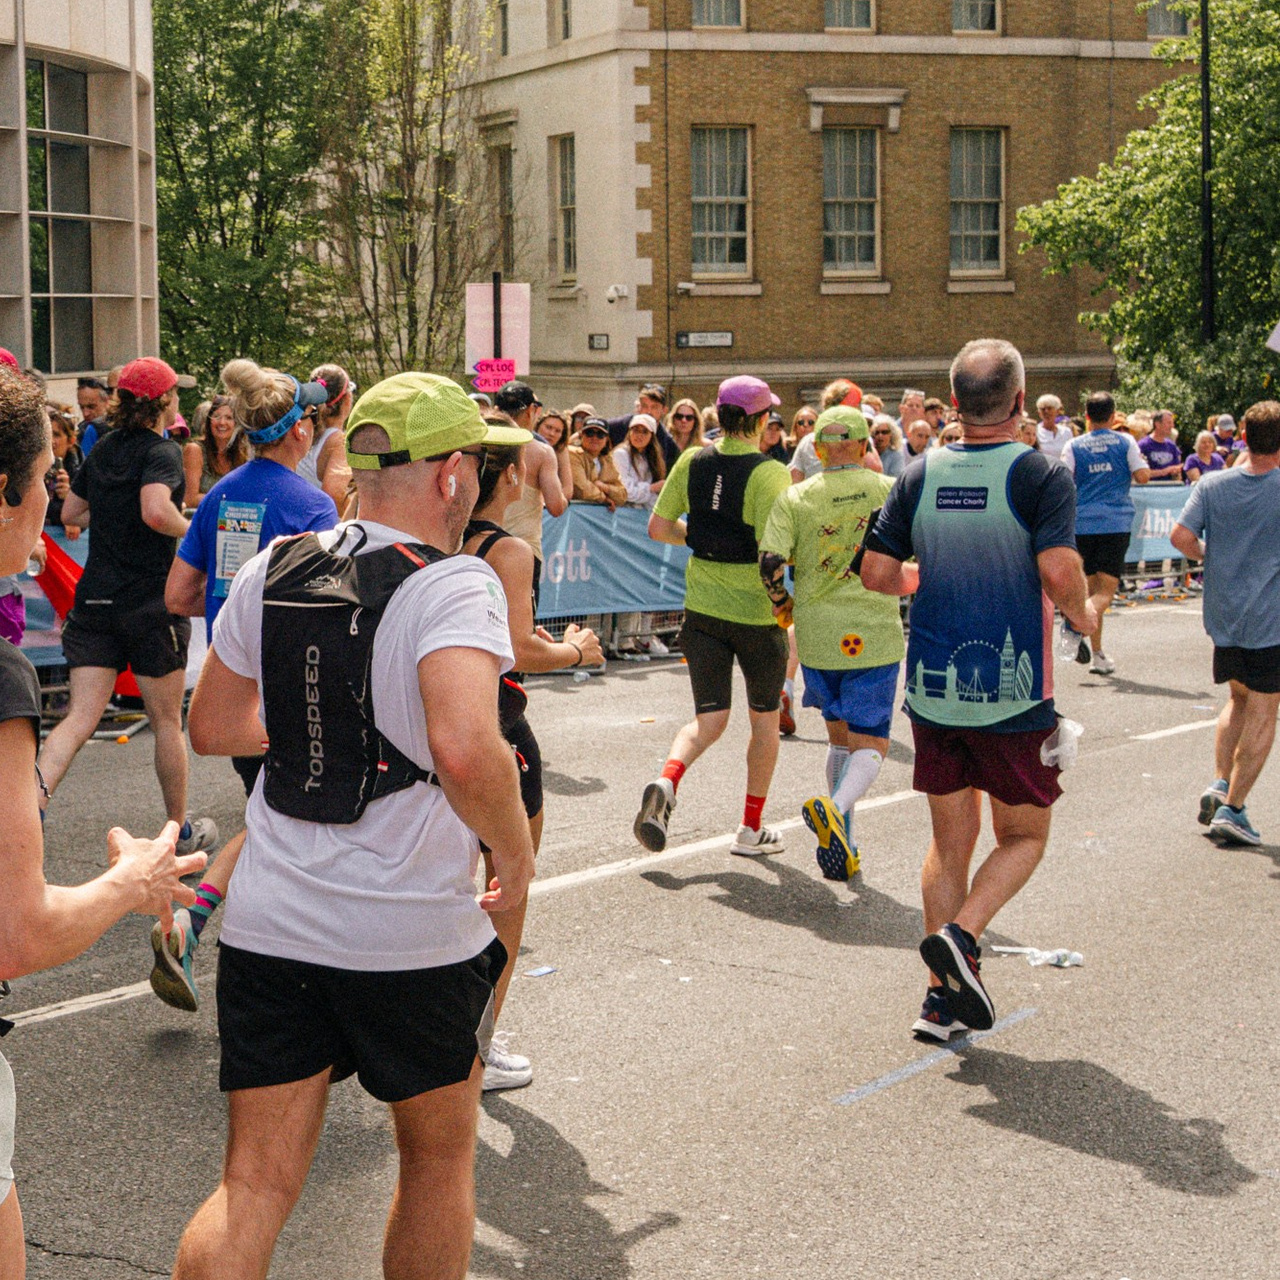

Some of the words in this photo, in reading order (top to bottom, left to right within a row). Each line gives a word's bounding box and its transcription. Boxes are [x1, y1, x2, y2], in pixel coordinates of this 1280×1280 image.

[1088, 462, 1113, 474] LUCA
[711, 474, 723, 511] KIPRUN
[938, 498, 962, 506] Cancer
[540, 538, 592, 584] ott
[305, 645, 324, 793] TOPSPEED
